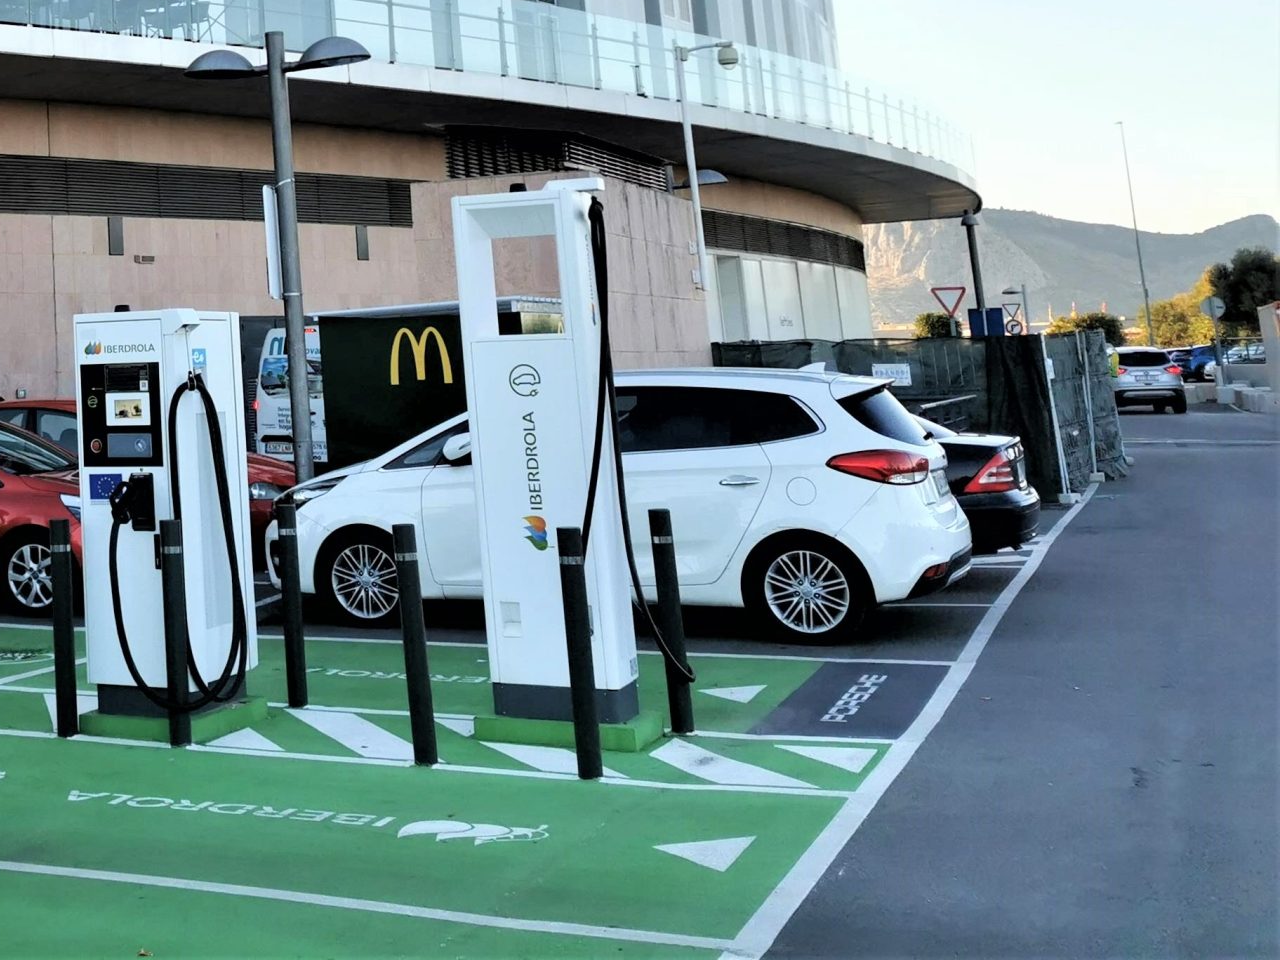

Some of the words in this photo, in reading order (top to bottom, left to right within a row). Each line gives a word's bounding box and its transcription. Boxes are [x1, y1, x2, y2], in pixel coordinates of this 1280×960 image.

[104, 343, 155, 354] IBERDROLA
[522, 411, 543, 510] IBERDROLA
[820, 674, 888, 723] PORSCHE
[68, 790, 396, 827] IBERDROLA
